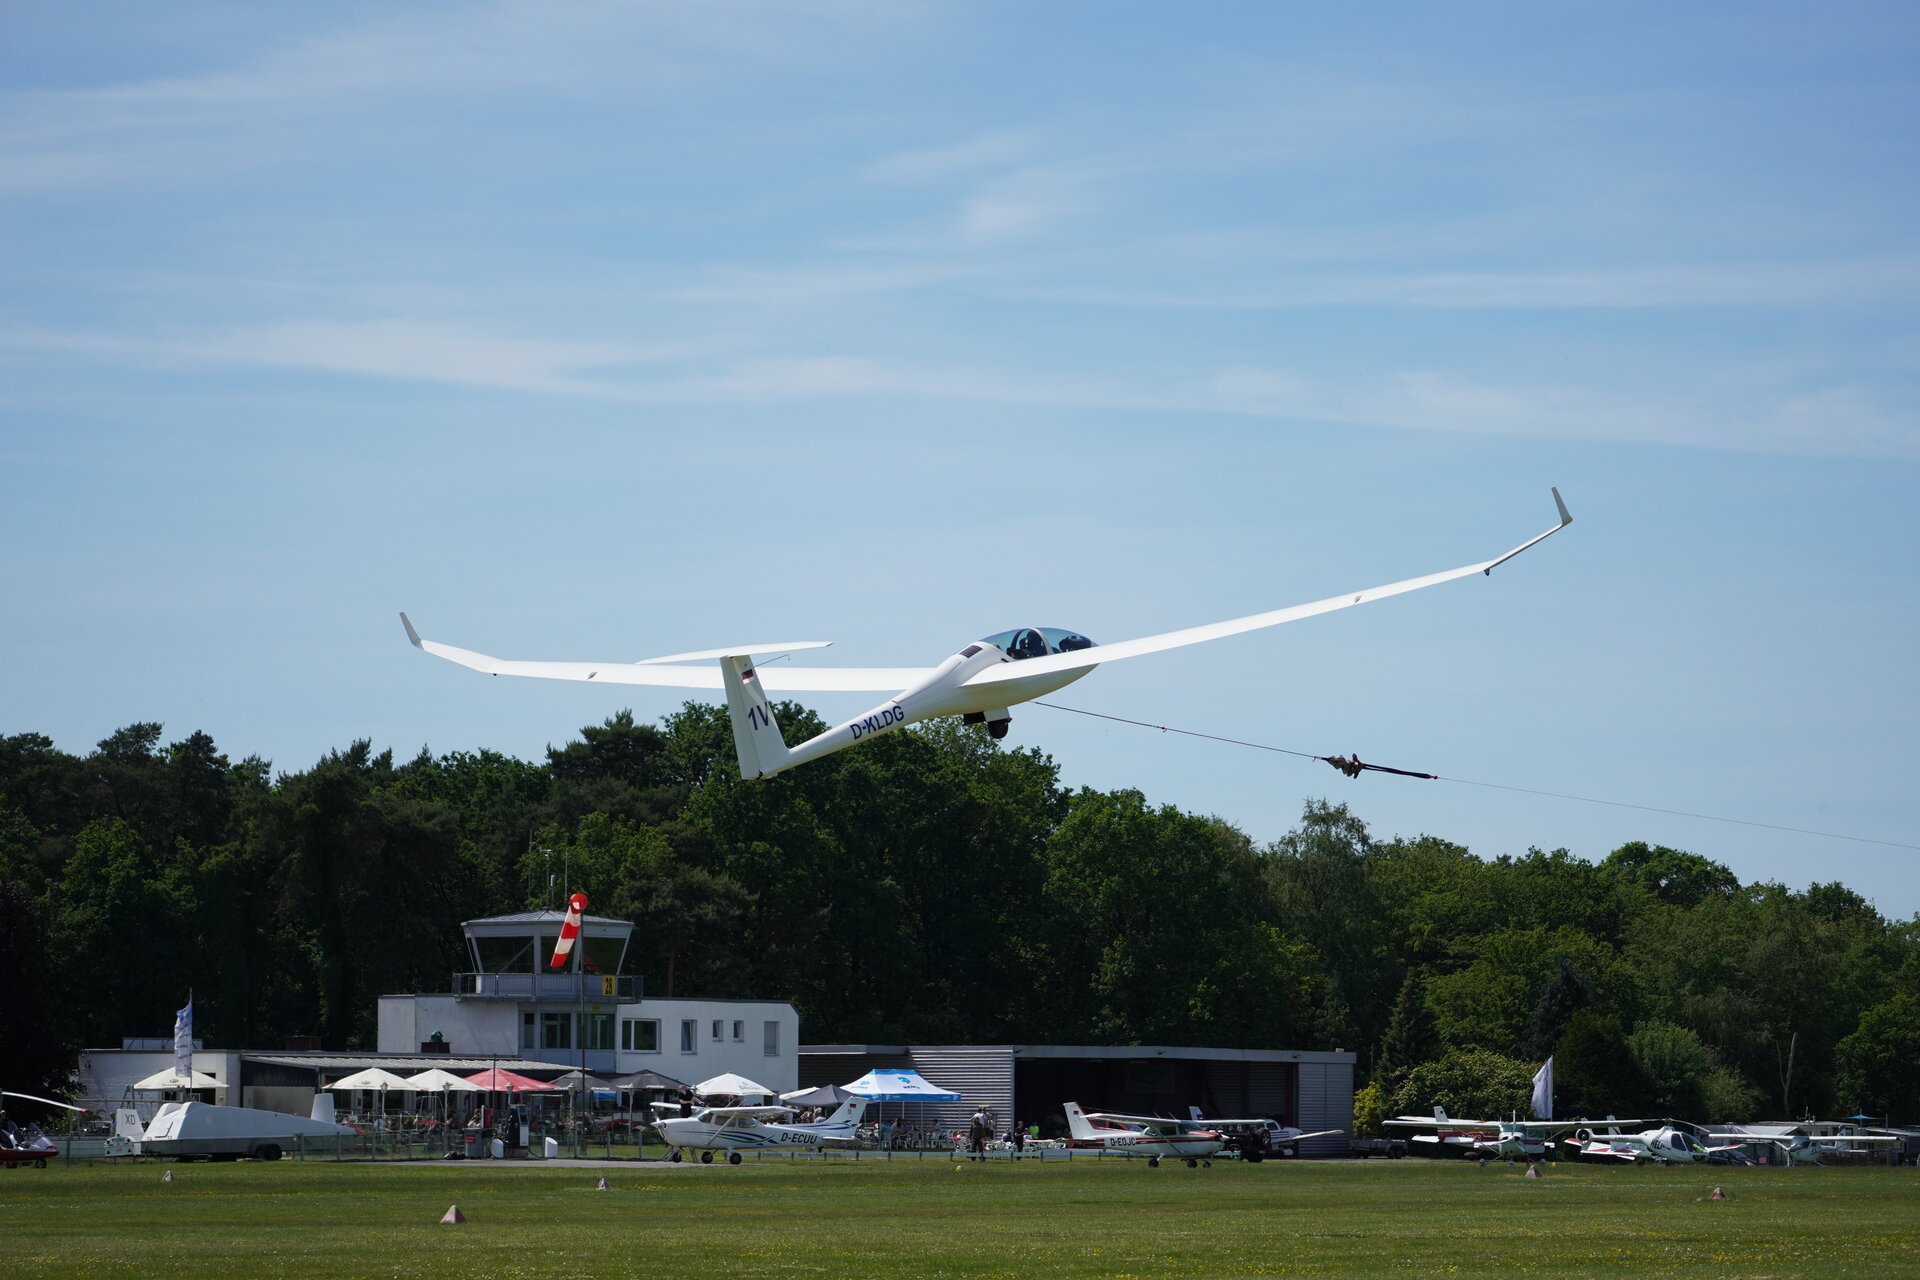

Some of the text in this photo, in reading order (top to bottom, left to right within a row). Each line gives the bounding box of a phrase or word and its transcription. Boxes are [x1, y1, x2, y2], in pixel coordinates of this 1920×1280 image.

[748, 702, 769, 731] 1V
[850, 705, 905, 740] D-KLDG
[125, 1113, 136, 1126] XD
[780, 1132, 818, 1145] D-ECUU
